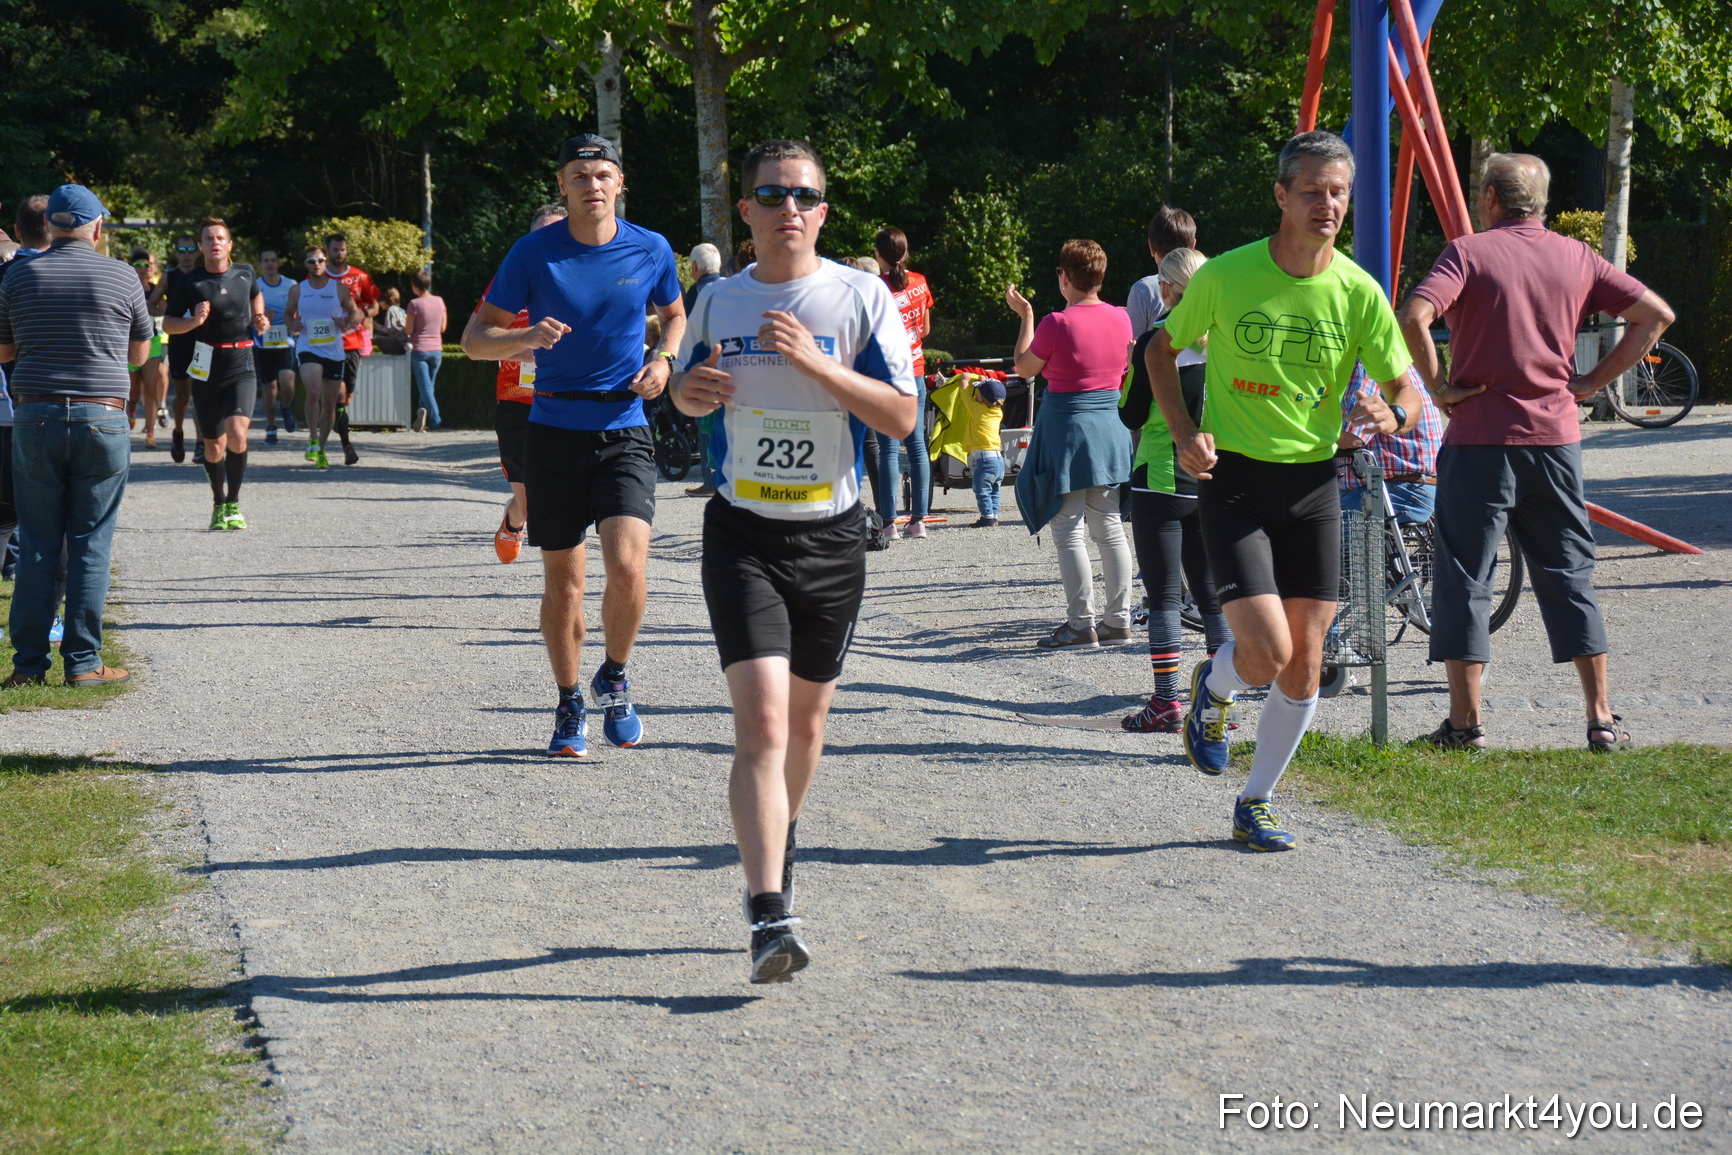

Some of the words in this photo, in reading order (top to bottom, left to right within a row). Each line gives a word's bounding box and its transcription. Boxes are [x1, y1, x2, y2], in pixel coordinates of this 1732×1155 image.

[901, 306, 921, 322] box
[268, 331, 281, 339] 211
[313, 325, 330, 335] 328
[1233, 377, 1281, 397] MERZ
[763, 417, 811, 431] BOCK
[756, 437, 815, 469] 232
[753, 471, 775, 480] PARTL
[776, 473, 808, 481] Neumarkt
[760, 485, 808, 501] Markus
